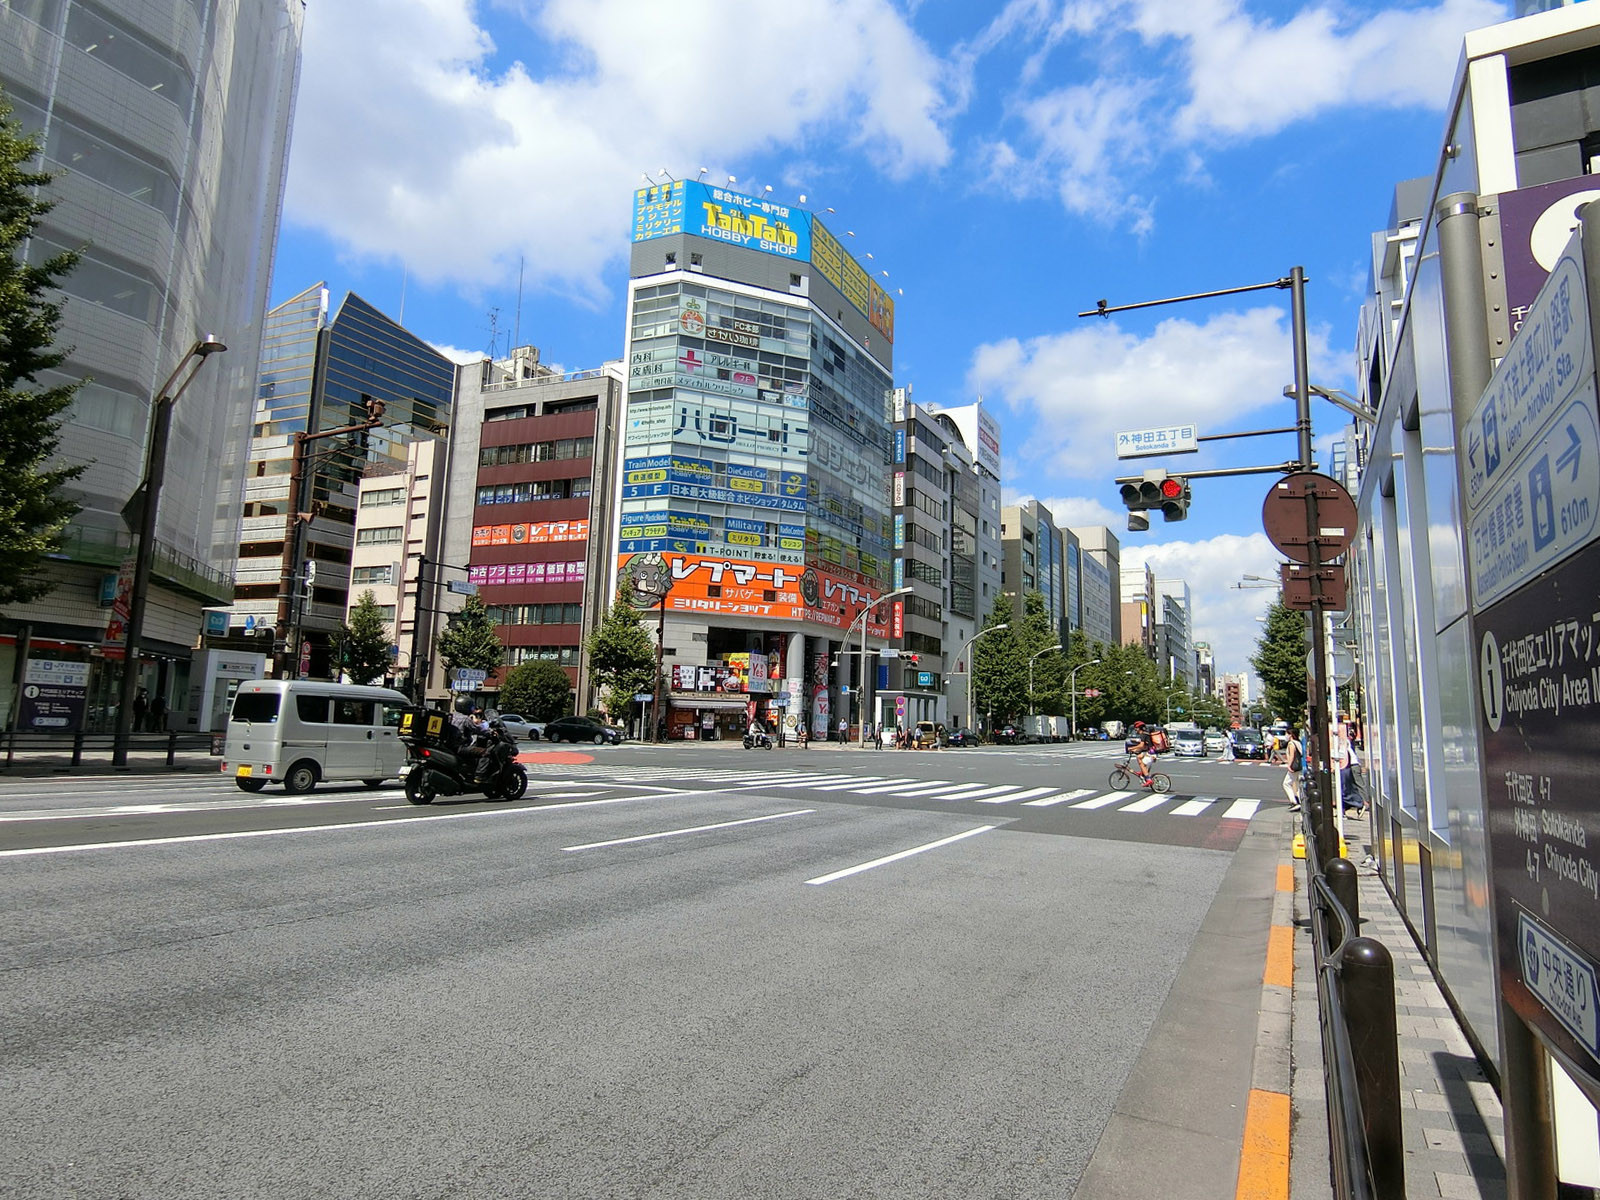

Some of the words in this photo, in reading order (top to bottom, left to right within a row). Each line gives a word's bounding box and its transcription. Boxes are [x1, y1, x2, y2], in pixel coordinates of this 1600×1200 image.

[638, 199, 682, 214] プラモデル
[713, 189, 790, 218] 総合ホビー専門店
[637, 209, 681, 223] ラジコン
[637, 218, 681, 232] ミリタリー
[702, 201, 798, 248] TamTam
[701, 225, 751, 245] HOBBY
[759, 240, 797, 256] SHOP
[711, 355, 751, 371] アレルギー科
[1555, 352, 1575, 388] Sta.
[1119, 428, 1193, 446] 外神田五丁目
[1135, 442, 1169, 451] Sotokanda
[628, 460, 647, 470] Train
[648, 457, 672, 469] Model
[727, 466, 754, 477] DieCast
[755, 468, 767, 479] Car
[631, 486, 638, 497] 5
[653, 484, 662, 495] F
[732, 479, 762, 491] ミニカー
[671, 484, 735, 502] 日本最大級総合
[781, 500, 804, 511] タムタム
[622, 514, 644, 524] Figure
[1561, 497, 1590, 535] 610m
[530, 523, 588, 537] レプマート
[727, 519, 763, 532] Military
[627, 540, 635, 551] 4
[650, 541, 660, 551] F
[731, 533, 759, 543] ミリタリー
[709, 546, 749, 559] T-POINT
[671, 556, 798, 589] レプマート
[724, 588, 763, 600] サバゲー
[778, 592, 799, 604] 装備
[824, 577, 876, 610] レプマート
[673, 598, 773, 615] ミリタリーショップ
[1505, 681, 1539, 719] Chiyoda
[1540, 677, 1560, 716] City
[1563, 673, 1591, 707] Area
[1505, 771, 1535, 806] 千代田区
[1514, 806, 1538, 844] 外神田
[1541, 808, 1587, 849] Sotokanda
[1526, 848, 1540, 883] 4-7
[1544, 843, 1579, 883] Chiyoda
[1579, 857, 1599, 900] City
[1541, 943, 1588, 1012] 中央通り
